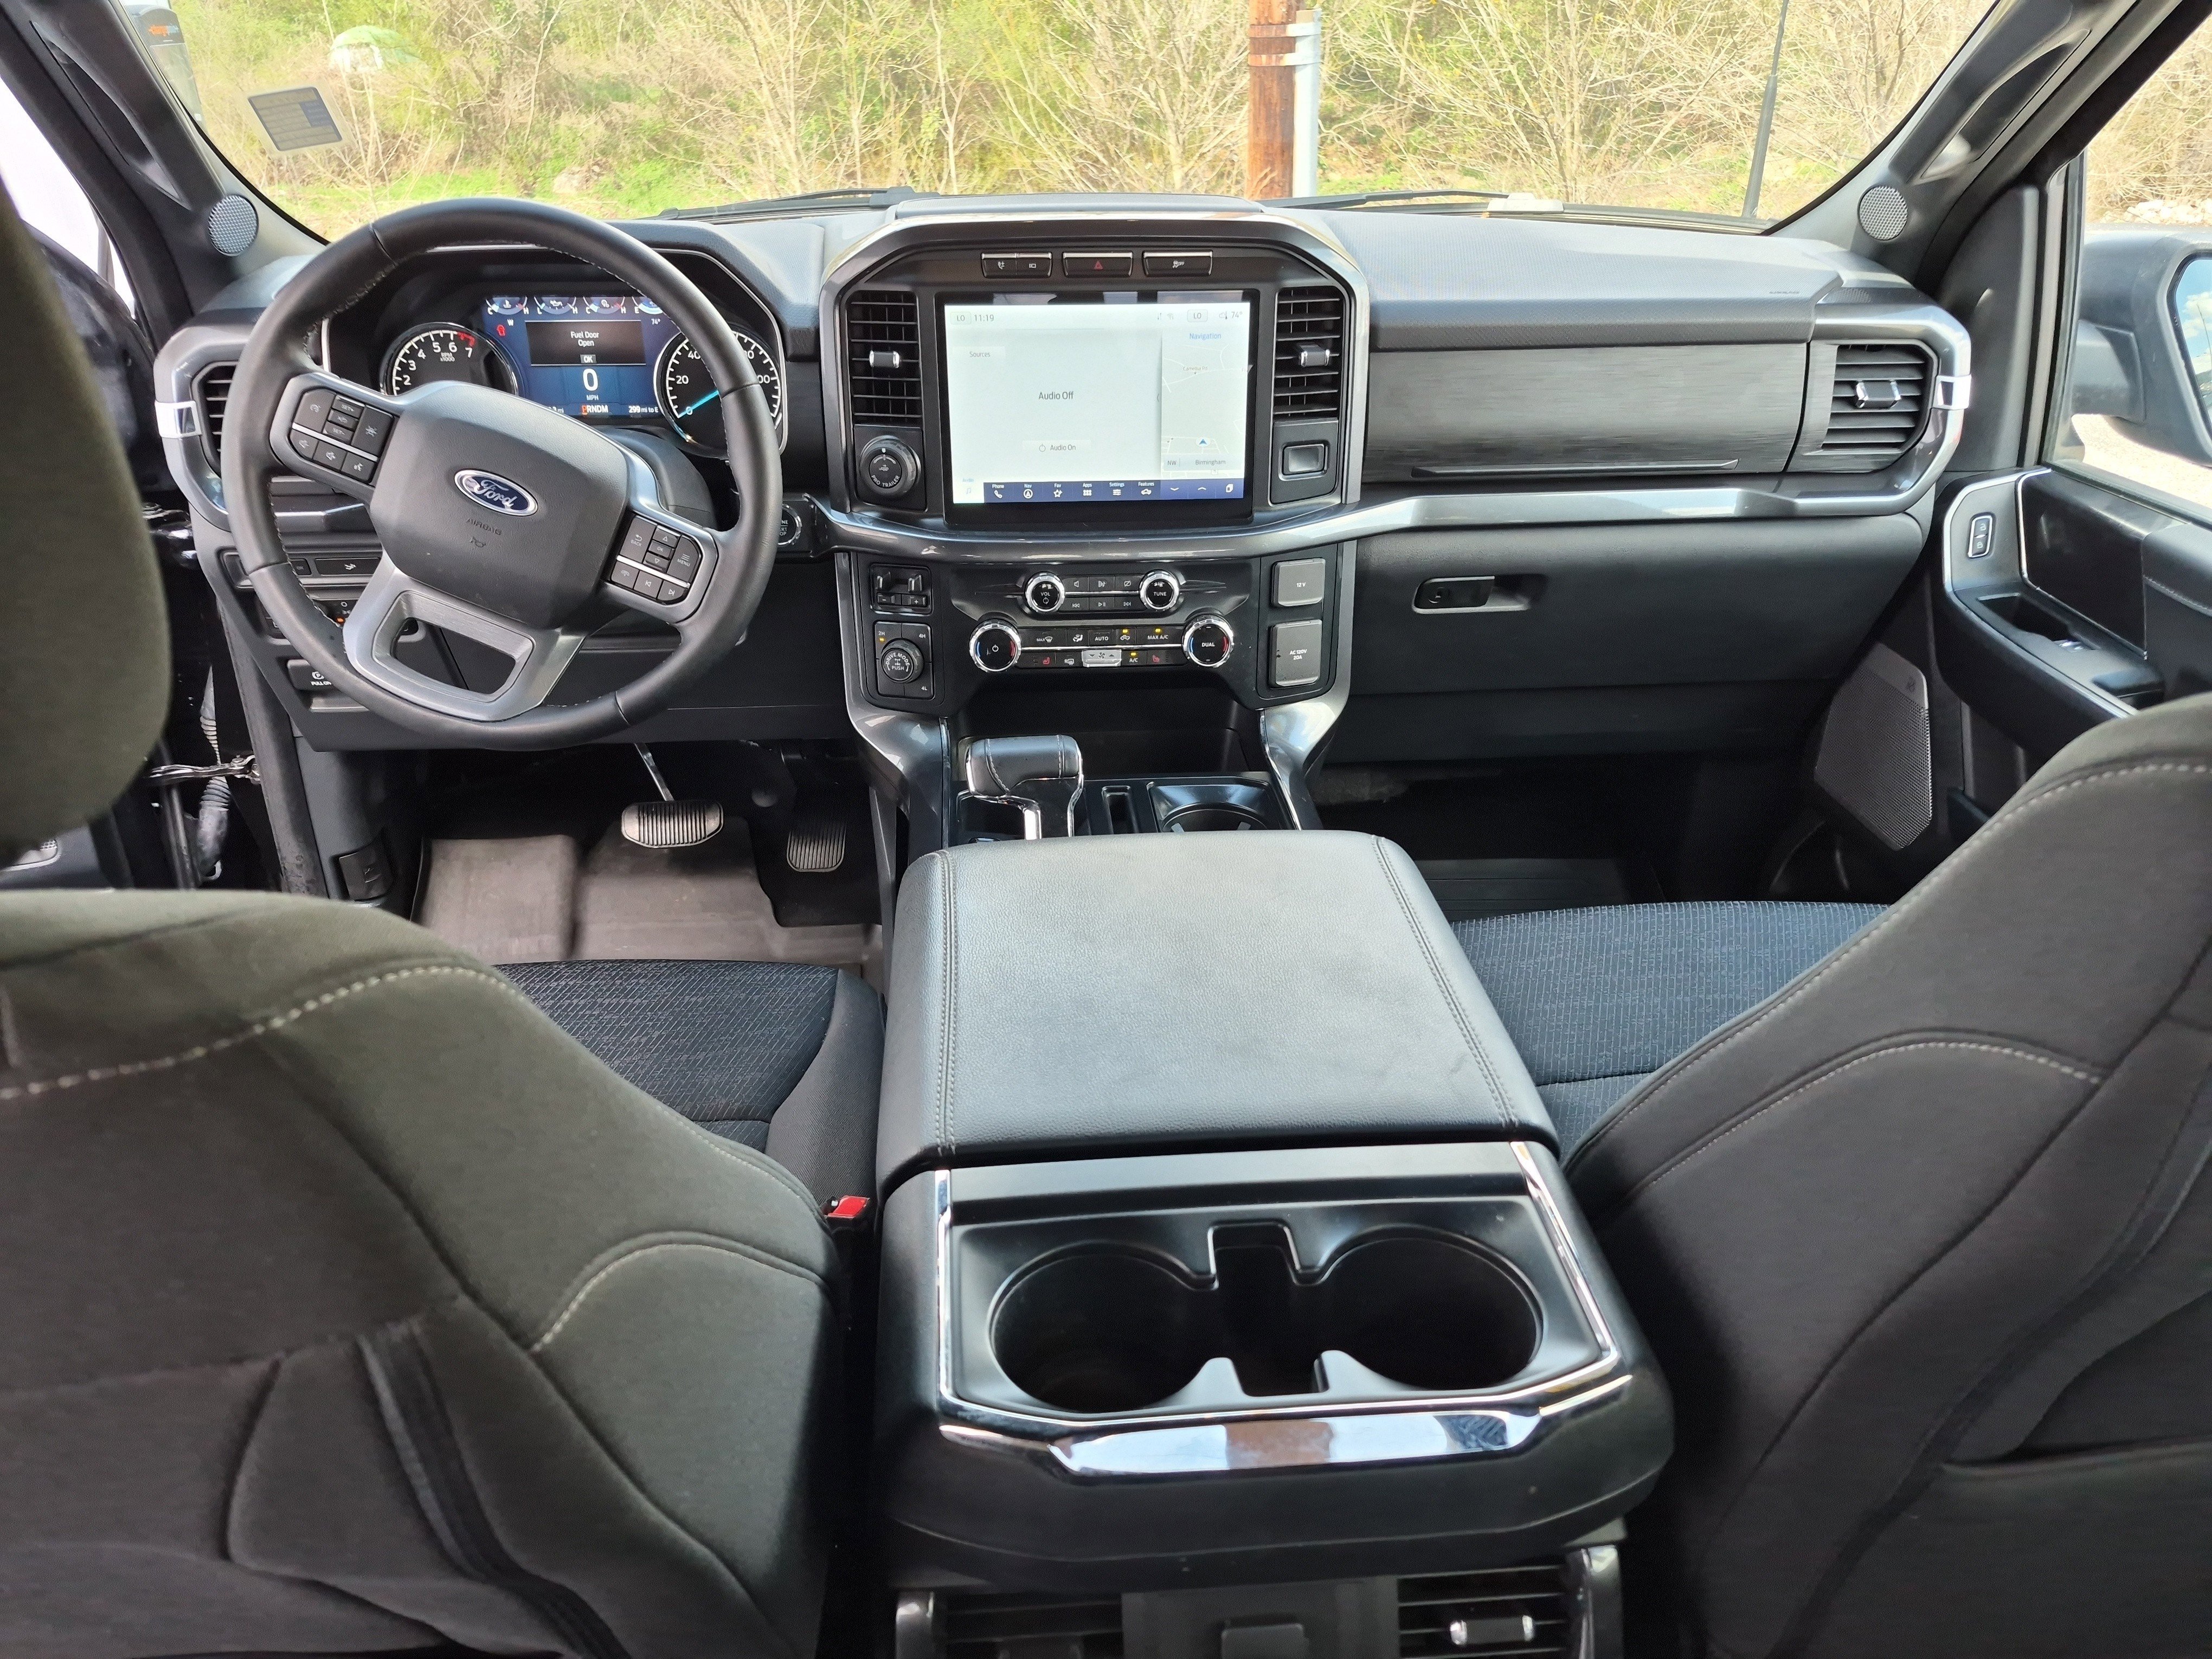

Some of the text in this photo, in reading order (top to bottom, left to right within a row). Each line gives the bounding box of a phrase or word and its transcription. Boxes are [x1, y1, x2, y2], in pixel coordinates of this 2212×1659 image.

[433, 342, 441, 352] 5
[448, 342, 457, 352] 6
[578, 339, 594, 348] Open
[417, 349, 426, 359] 4
[465, 347, 473, 358] 7
[408, 360, 416, 370] 3
[403, 375, 411, 385] 2
[583, 369, 598, 391] 0
[676, 375, 689, 384] 20
[1039, 391, 1074, 400] Audio Off
[871, 475, 900, 487] PRO TRAILER
[474, 479, 517, 507] Ford
[677, 558, 690, 567] MENU
[885, 653, 910, 666] DRIVE MODE
